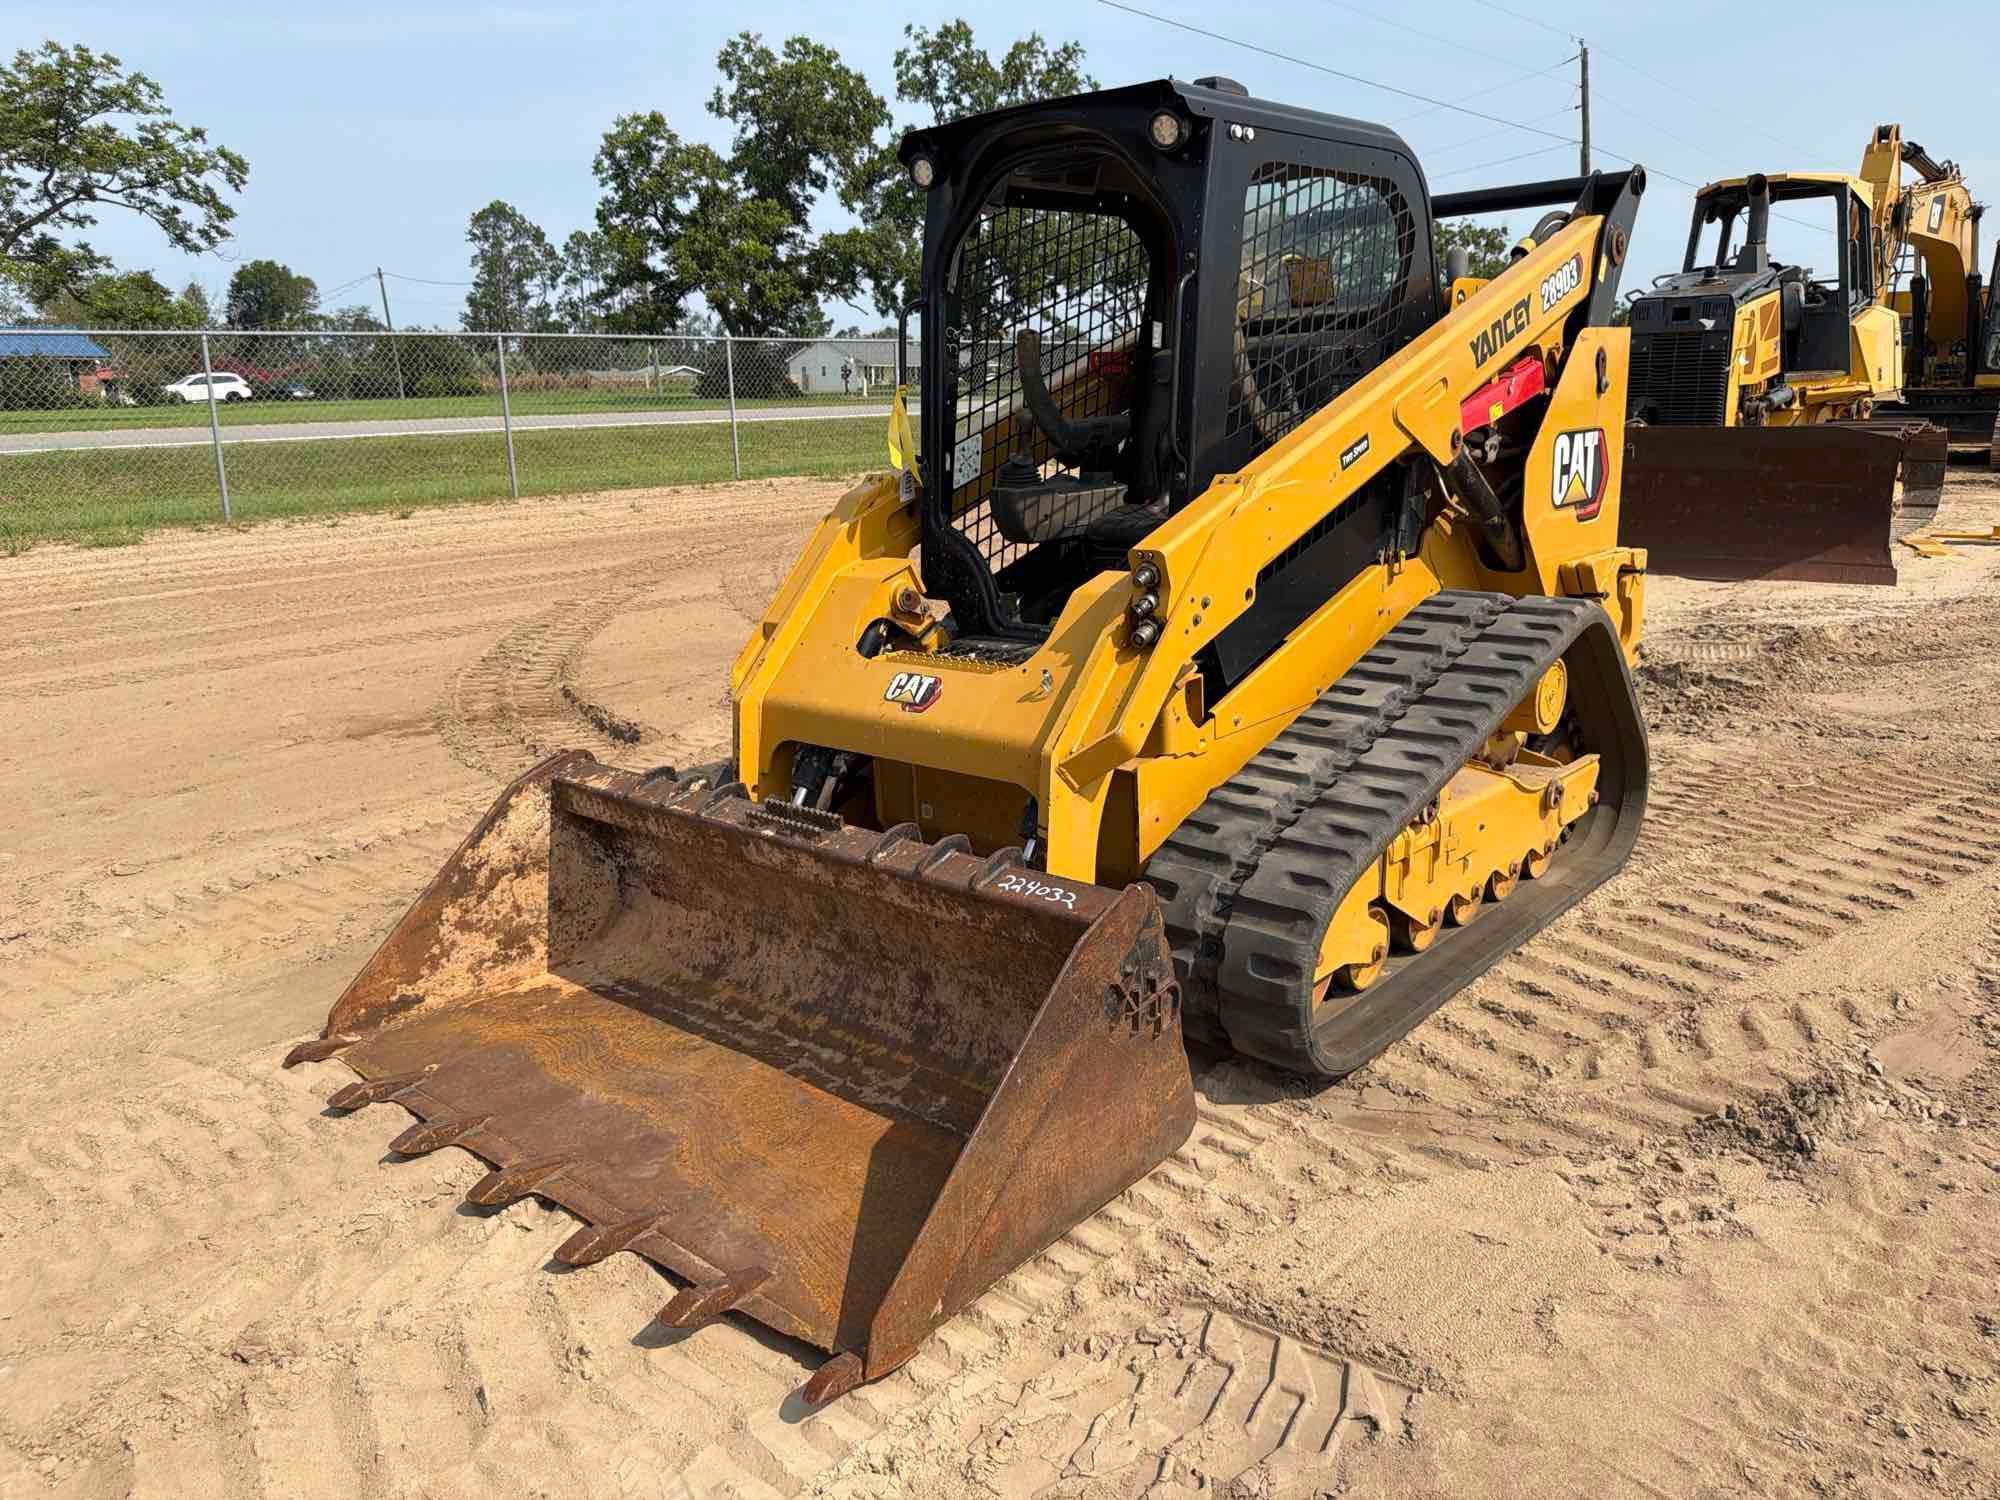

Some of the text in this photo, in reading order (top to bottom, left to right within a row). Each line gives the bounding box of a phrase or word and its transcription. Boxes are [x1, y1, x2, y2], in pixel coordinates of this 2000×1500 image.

[1541, 258, 1578, 313] 289D3
[1470, 293, 1531, 368] YANCEY
[1554, 432, 1599, 505] CAT
[884, 672, 936, 704] CAT
[998, 874, 1077, 910] 224032
